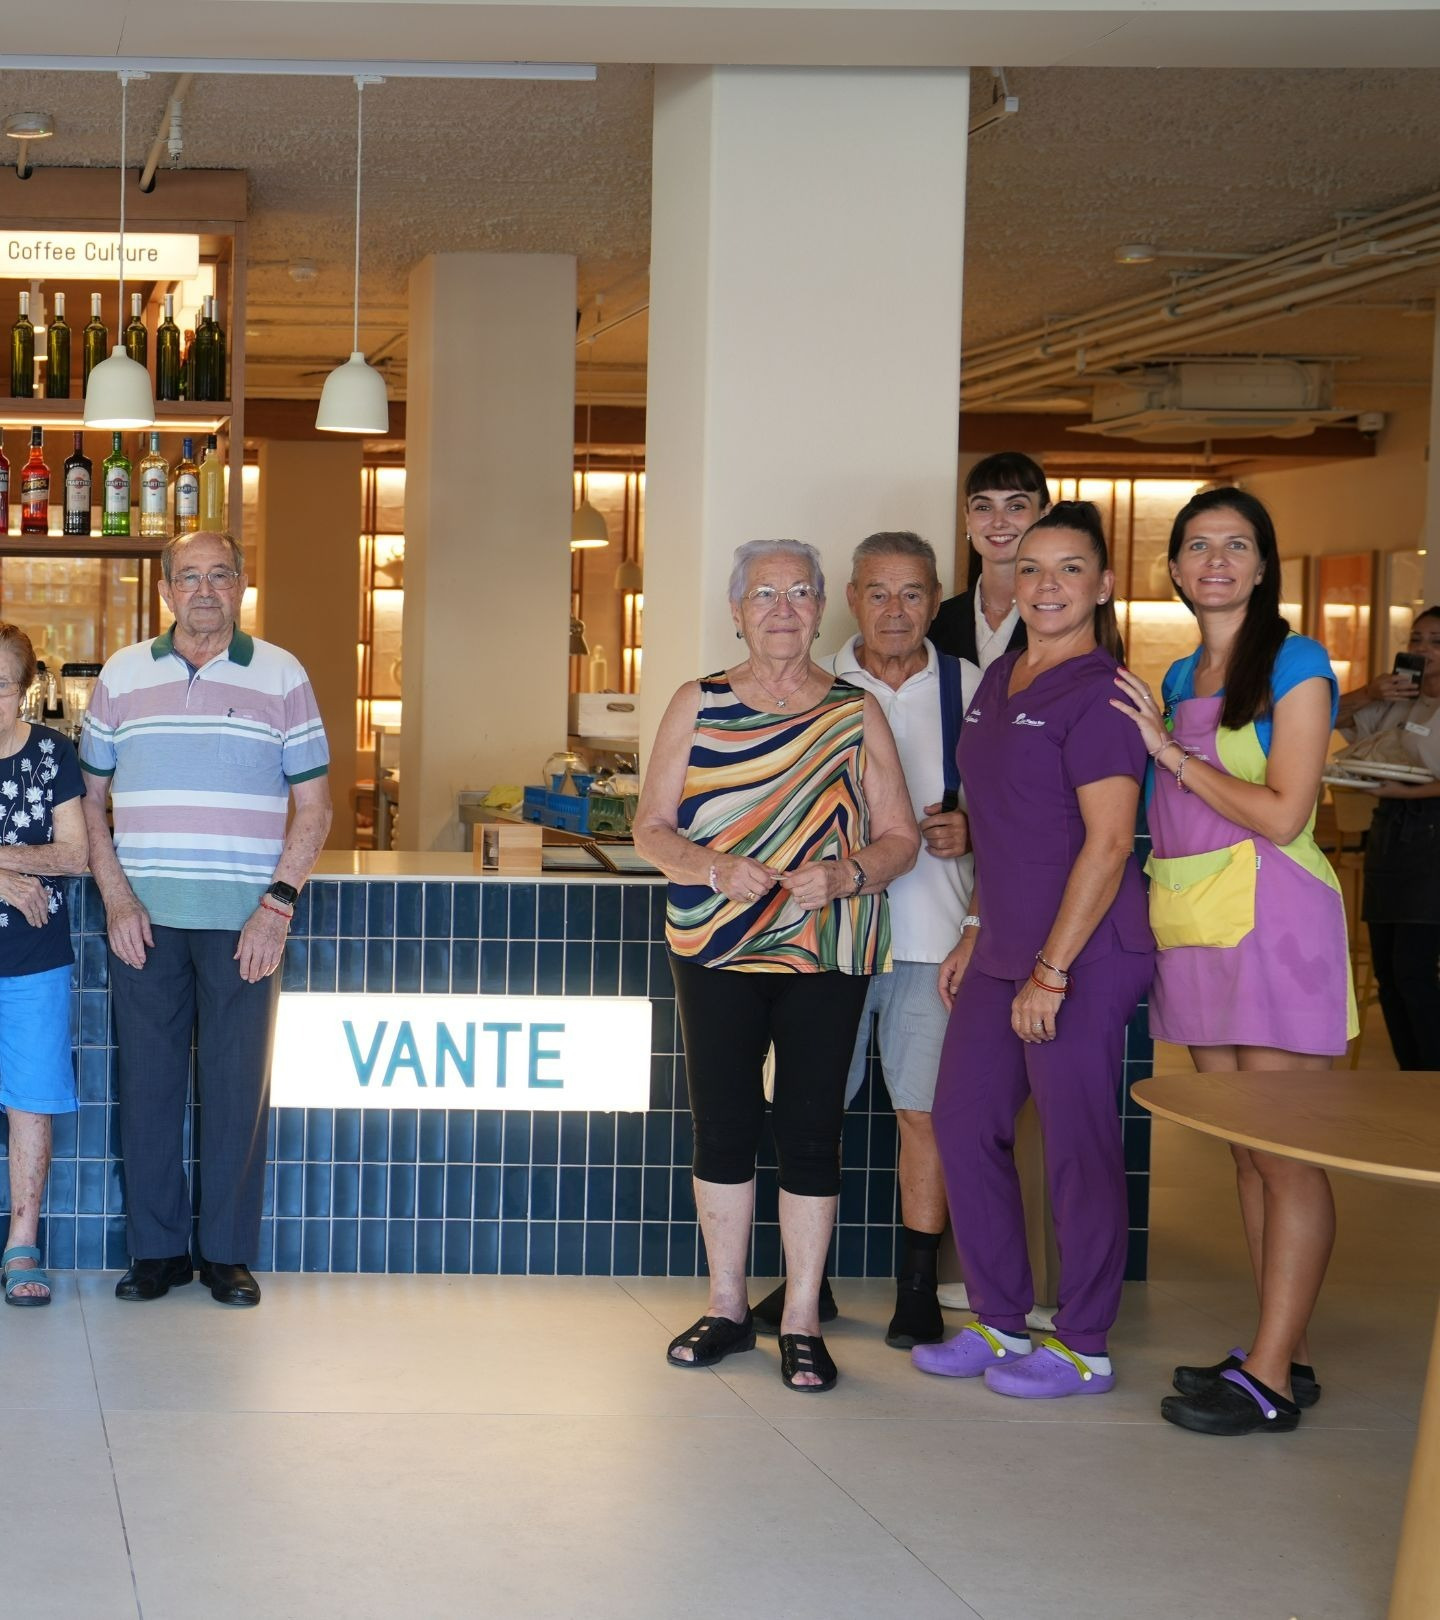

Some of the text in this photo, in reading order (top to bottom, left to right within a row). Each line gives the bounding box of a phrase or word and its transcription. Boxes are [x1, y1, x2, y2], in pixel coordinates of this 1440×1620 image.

[8, 240, 158, 262] Coffee Culture
[341, 1020, 566, 1089] VANTE
